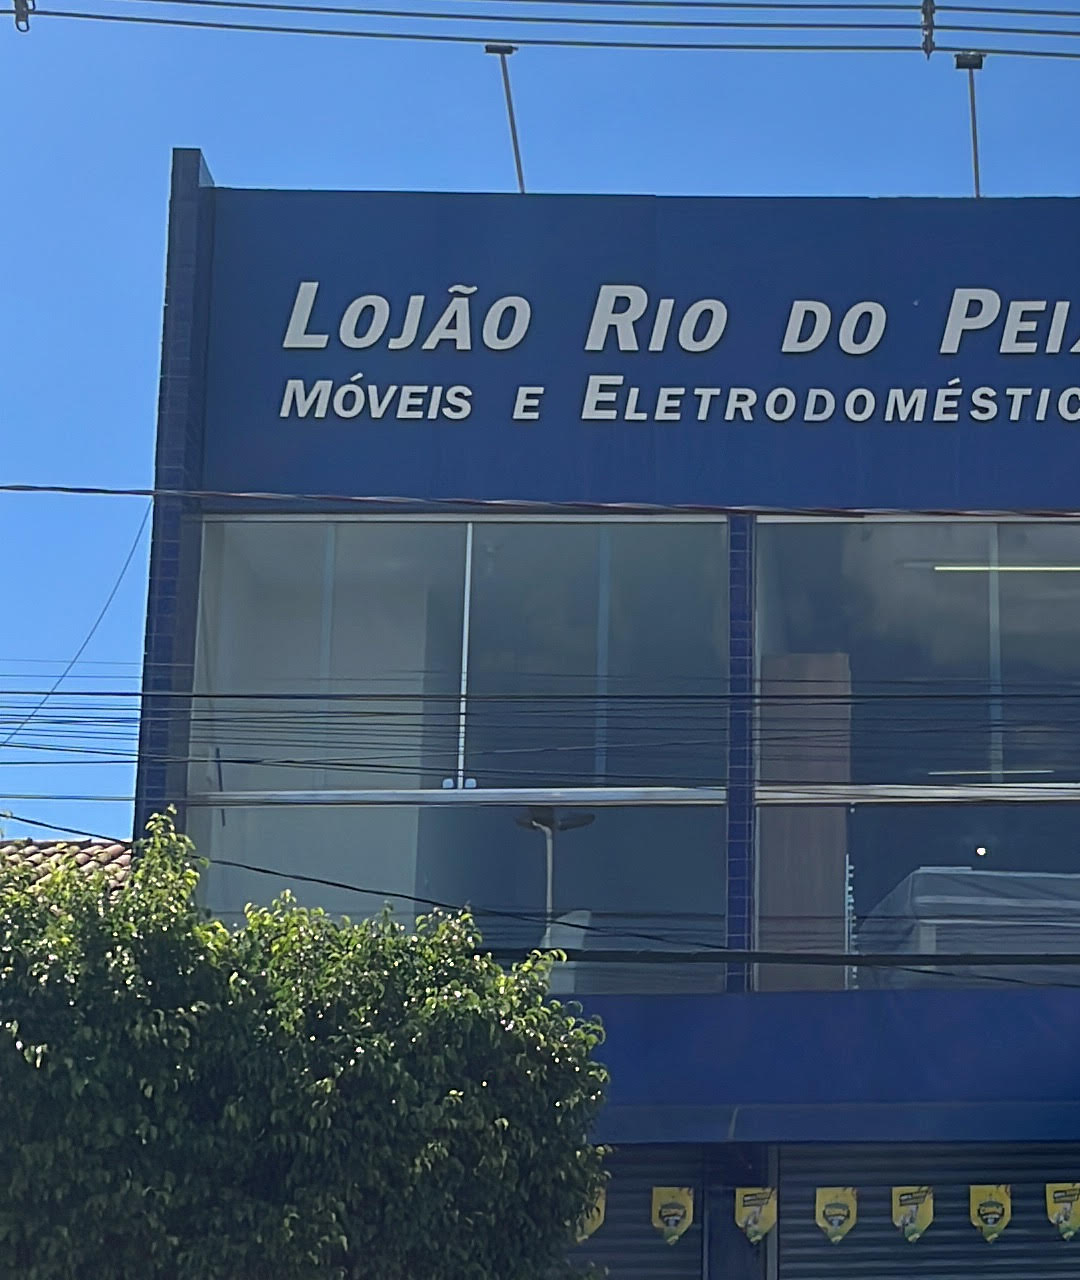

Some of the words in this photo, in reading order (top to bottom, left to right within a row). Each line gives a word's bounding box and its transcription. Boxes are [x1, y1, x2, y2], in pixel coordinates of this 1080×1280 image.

[283, 281, 532, 351] LOJÃO
[584, 284, 728, 352] RIO
[781, 300, 888, 355] DO
[280, 372, 472, 420] MÓVEIS
[513, 386, 544, 420] E
